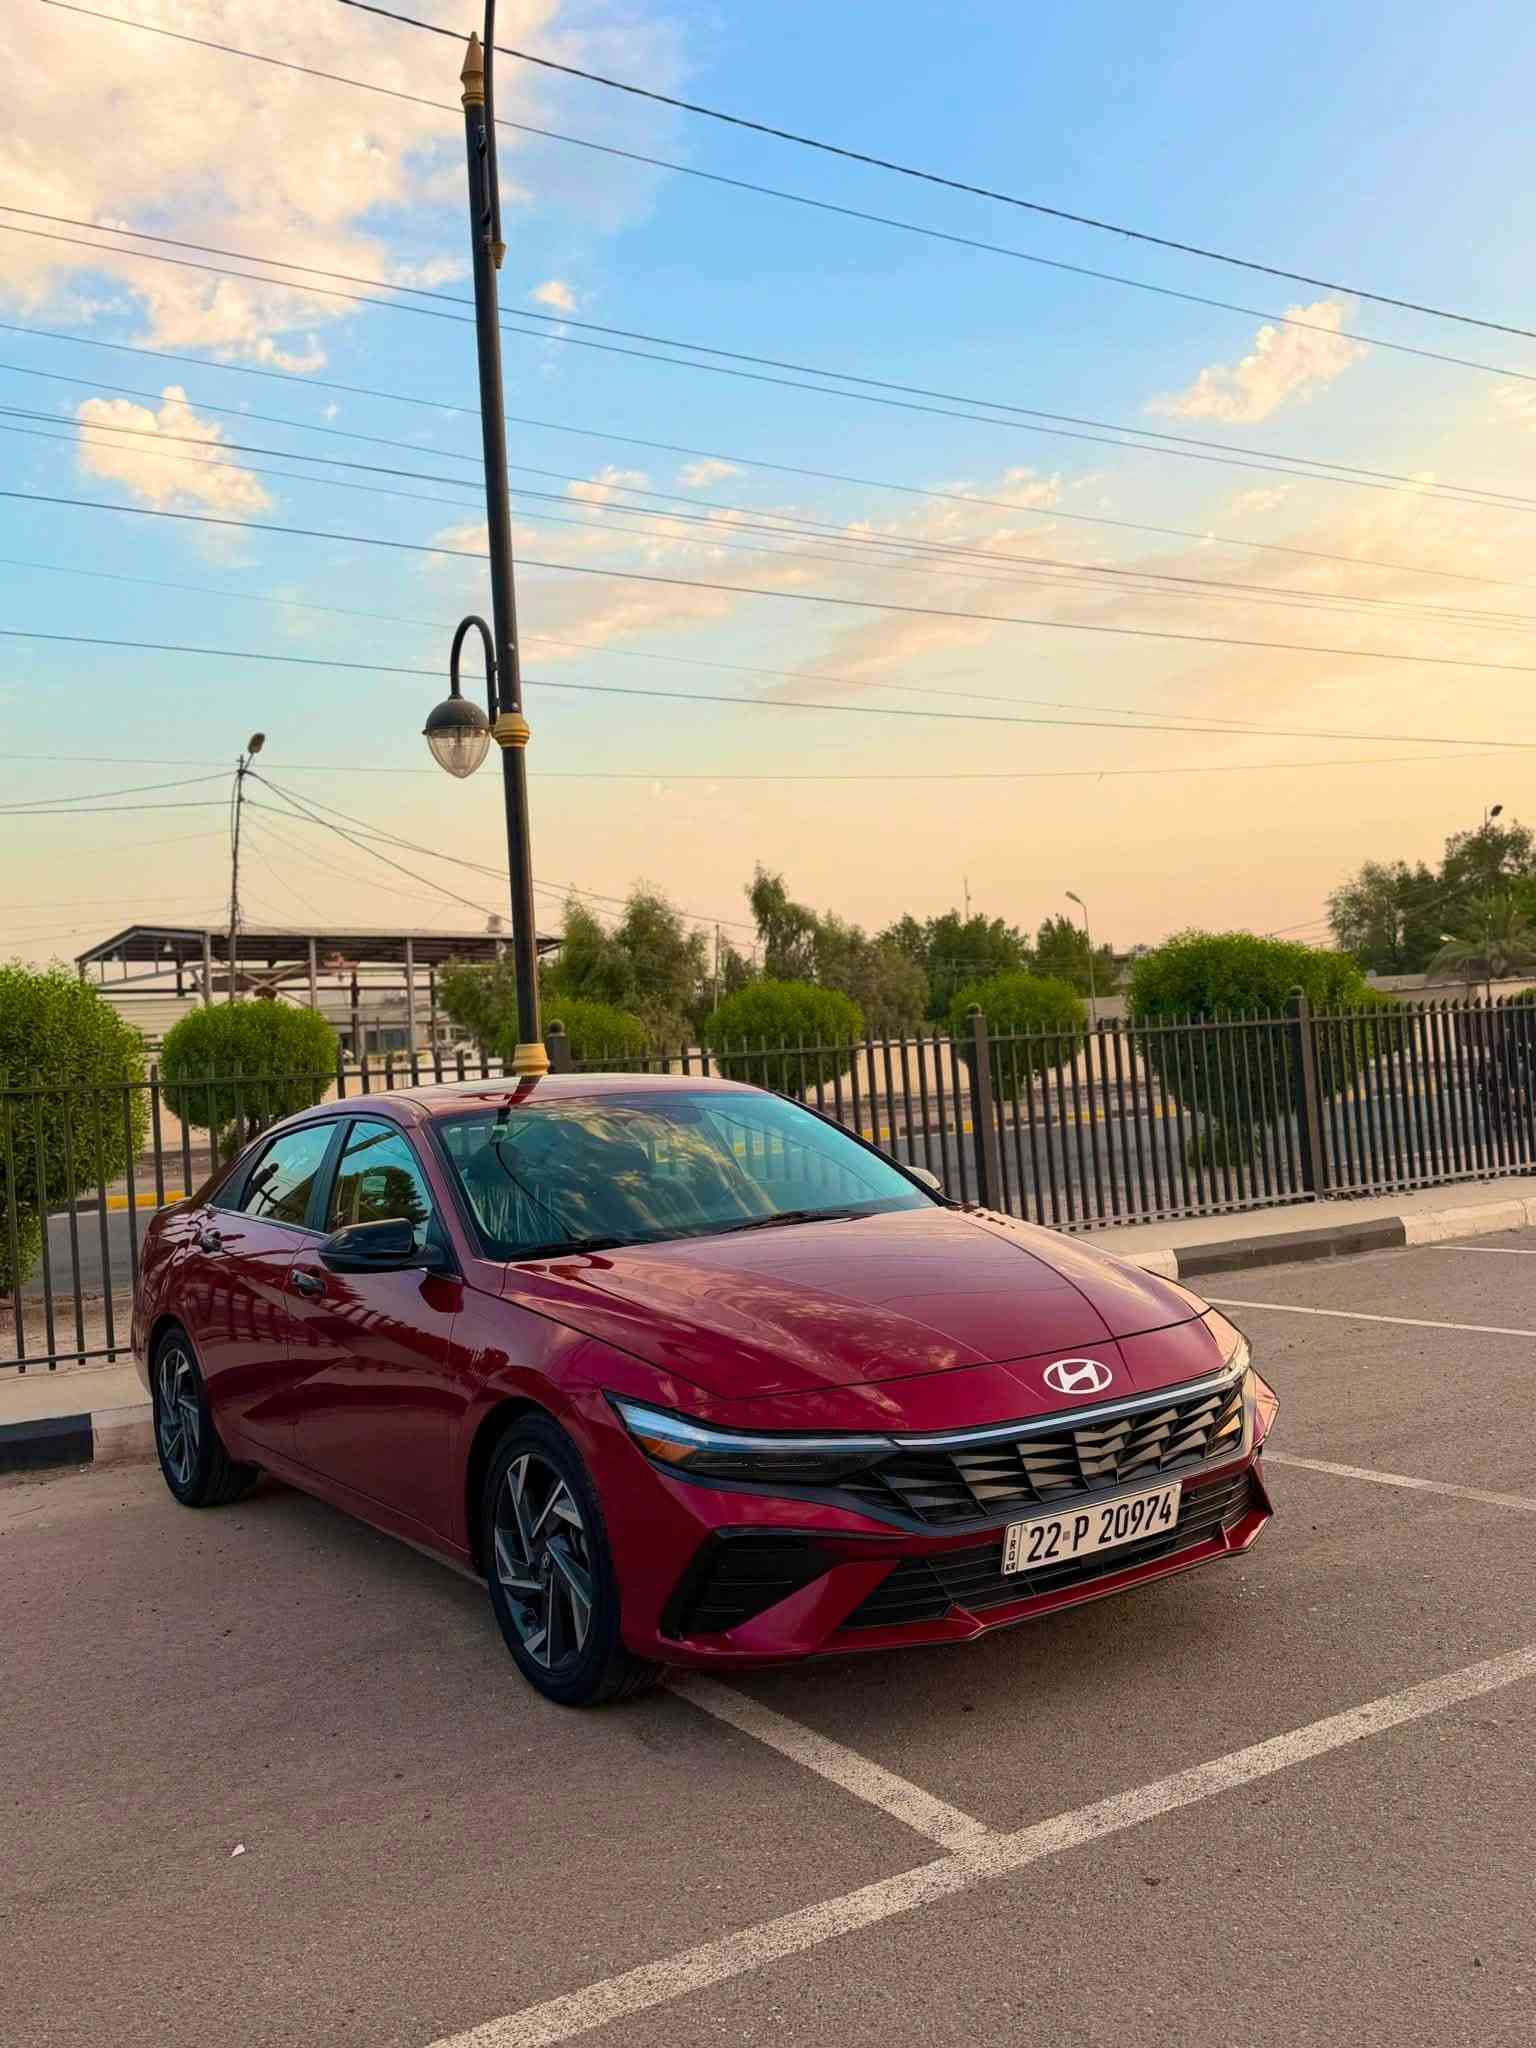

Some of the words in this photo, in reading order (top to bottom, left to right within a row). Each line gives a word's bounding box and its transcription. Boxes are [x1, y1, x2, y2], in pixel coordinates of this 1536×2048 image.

[1027, 1522, 1062, 1563] 22
[1072, 1515, 1090, 1551] P
[1098, 1492, 1171, 1544] 20974
